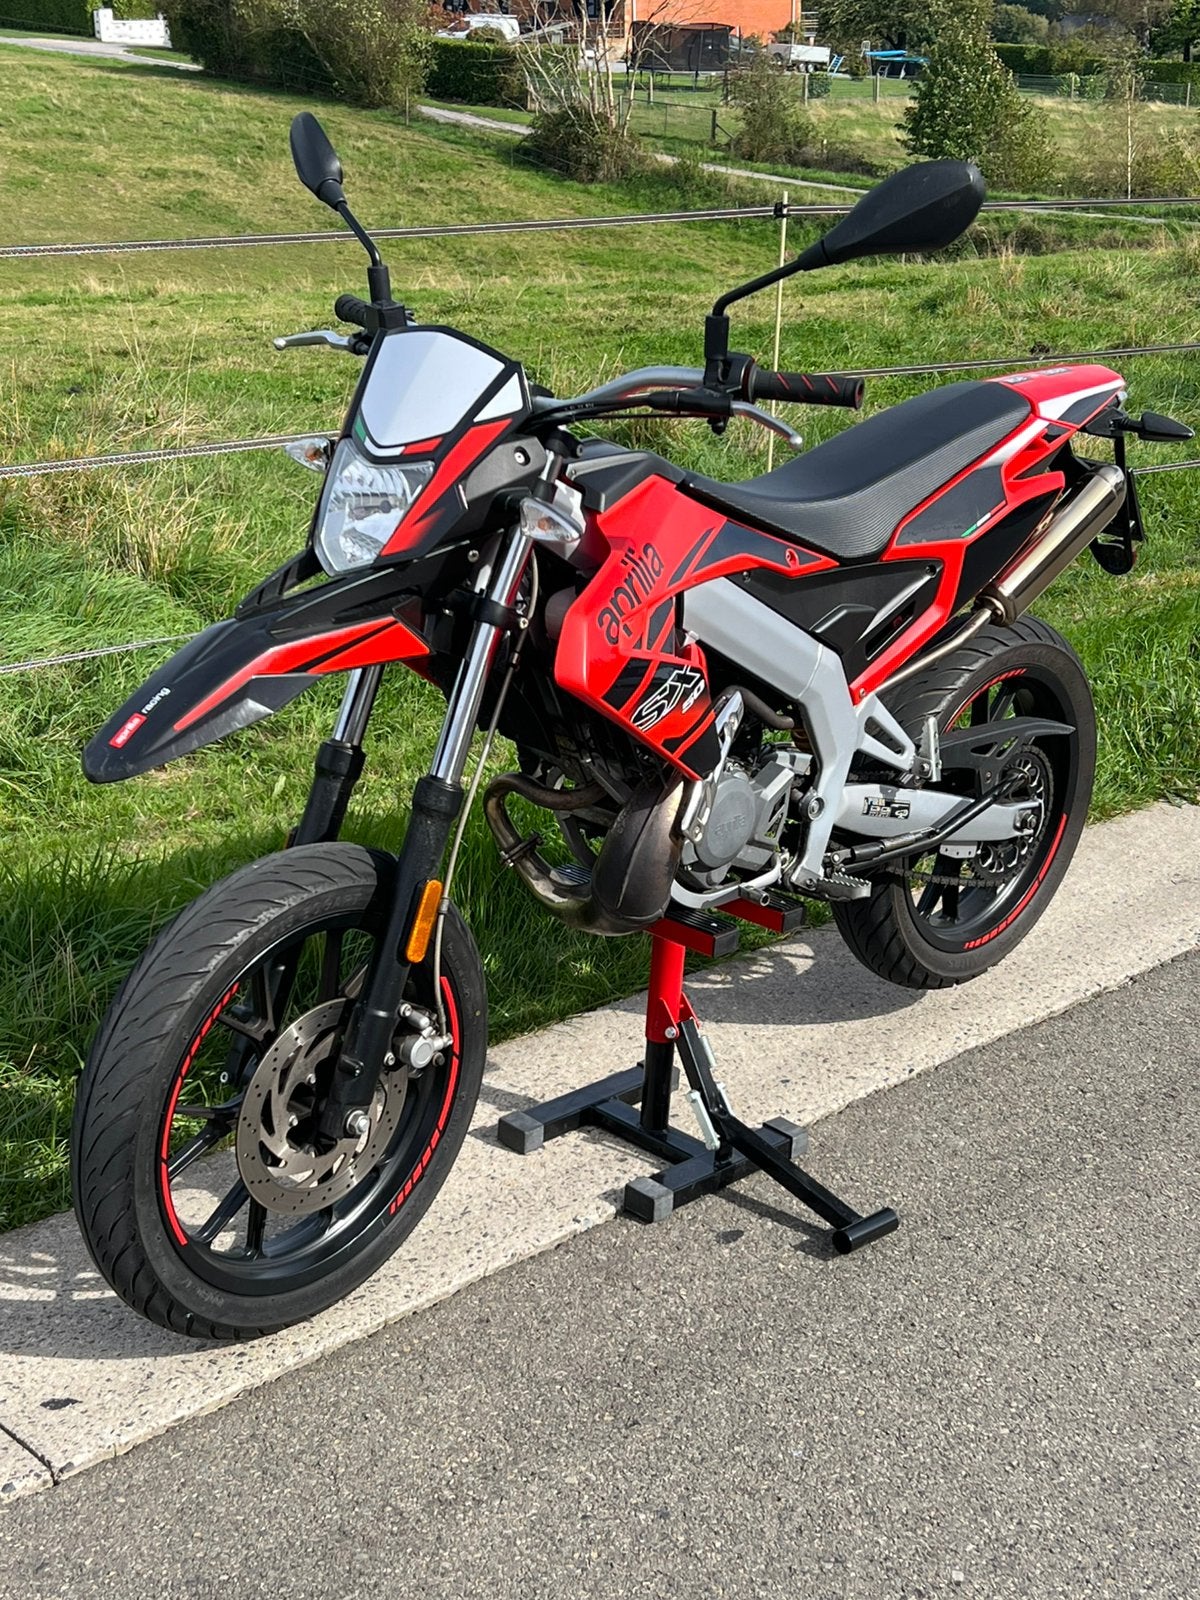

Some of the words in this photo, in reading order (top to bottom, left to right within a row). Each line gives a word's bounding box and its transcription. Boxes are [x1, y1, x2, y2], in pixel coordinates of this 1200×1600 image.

[597, 543, 665, 646] aprilia
[141, 686, 171, 714] racing
[629, 664, 701, 733] SX
